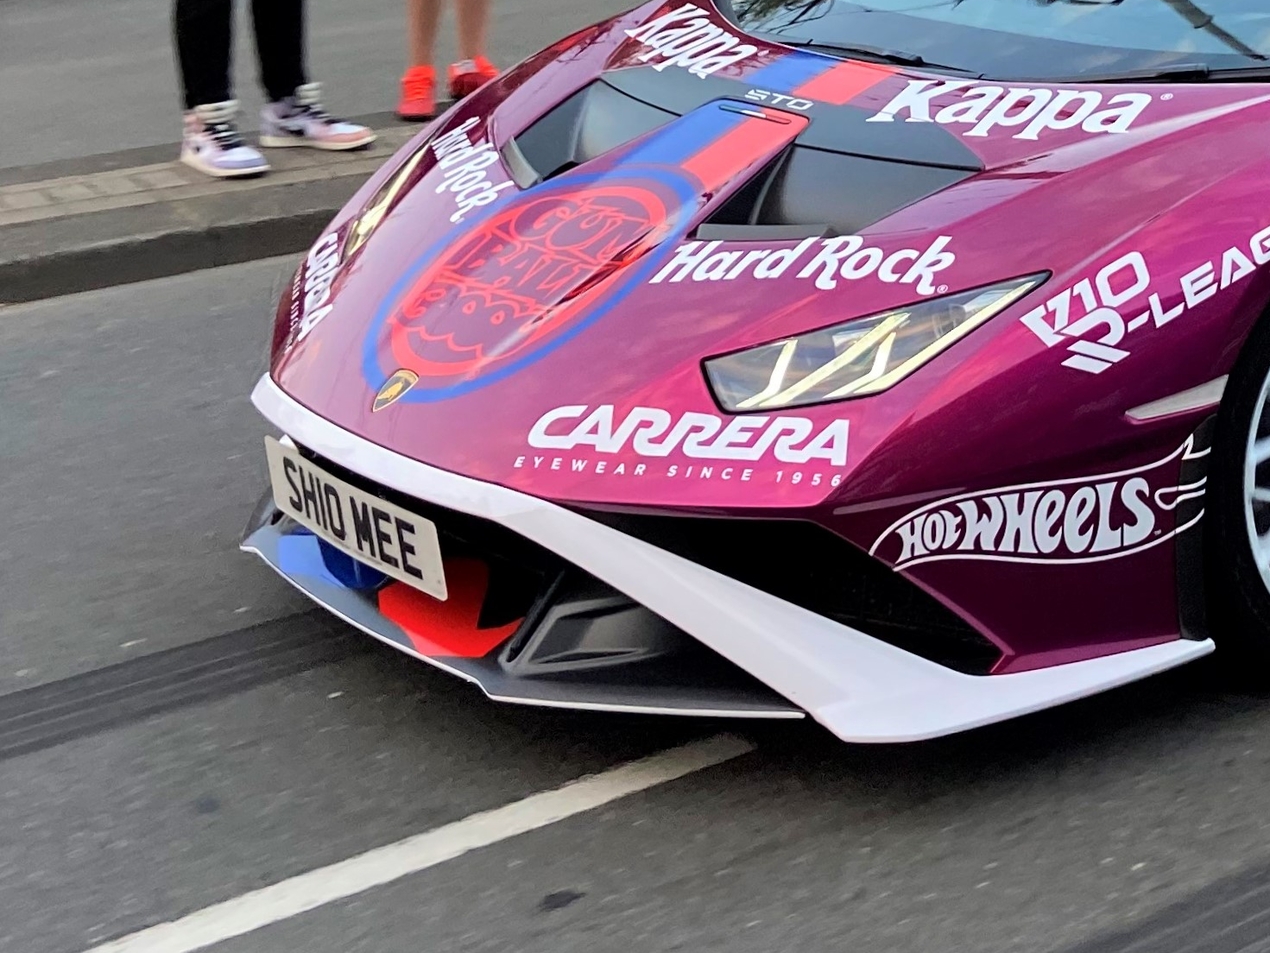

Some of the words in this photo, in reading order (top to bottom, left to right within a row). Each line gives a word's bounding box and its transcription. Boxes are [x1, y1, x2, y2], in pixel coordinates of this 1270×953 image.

[624, 2, 758, 79] Kappa
[745, 89, 814, 110] STO
[866, 79, 1154, 141] Kappa
[435, 151, 515, 223] Rock
[649, 235, 813, 285] Hard
[798, 235, 957, 295] Rock
[527, 404, 850, 466] CARRERA
[514, 456, 647, 476] EYEWEAR
[667, 464, 754, 482] SINCE
[775, 470, 842, 488] 1956
[349, 495, 424, 580] MEE
